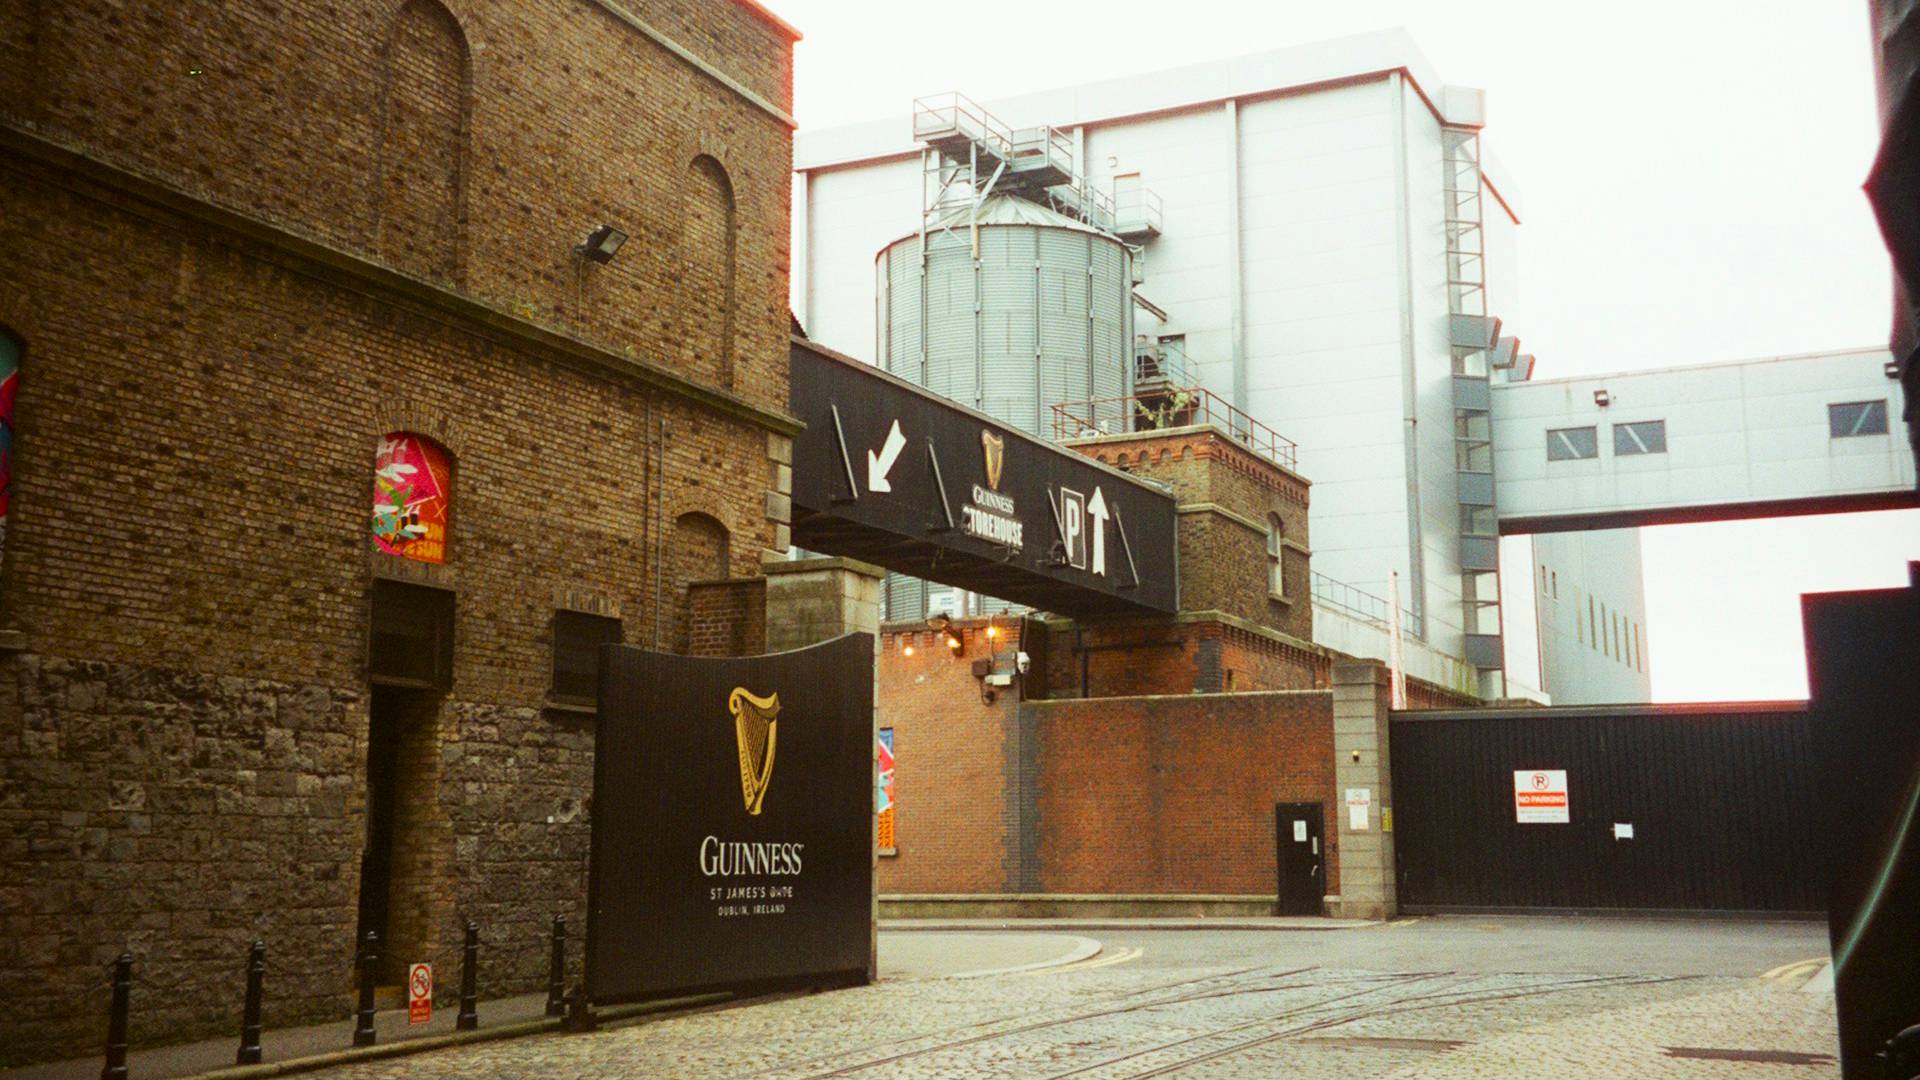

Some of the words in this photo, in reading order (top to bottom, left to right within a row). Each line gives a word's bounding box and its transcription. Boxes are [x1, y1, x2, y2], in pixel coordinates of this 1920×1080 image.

[973, 485, 1014, 514] GUINNESS
[1066, 498, 1080, 558] P
[700, 835, 802, 876] GUINNESS
[710, 888, 722, 900] ST
[726, 887, 766, 900] JAMES'S
[753, 904, 785, 914] IRELAND
